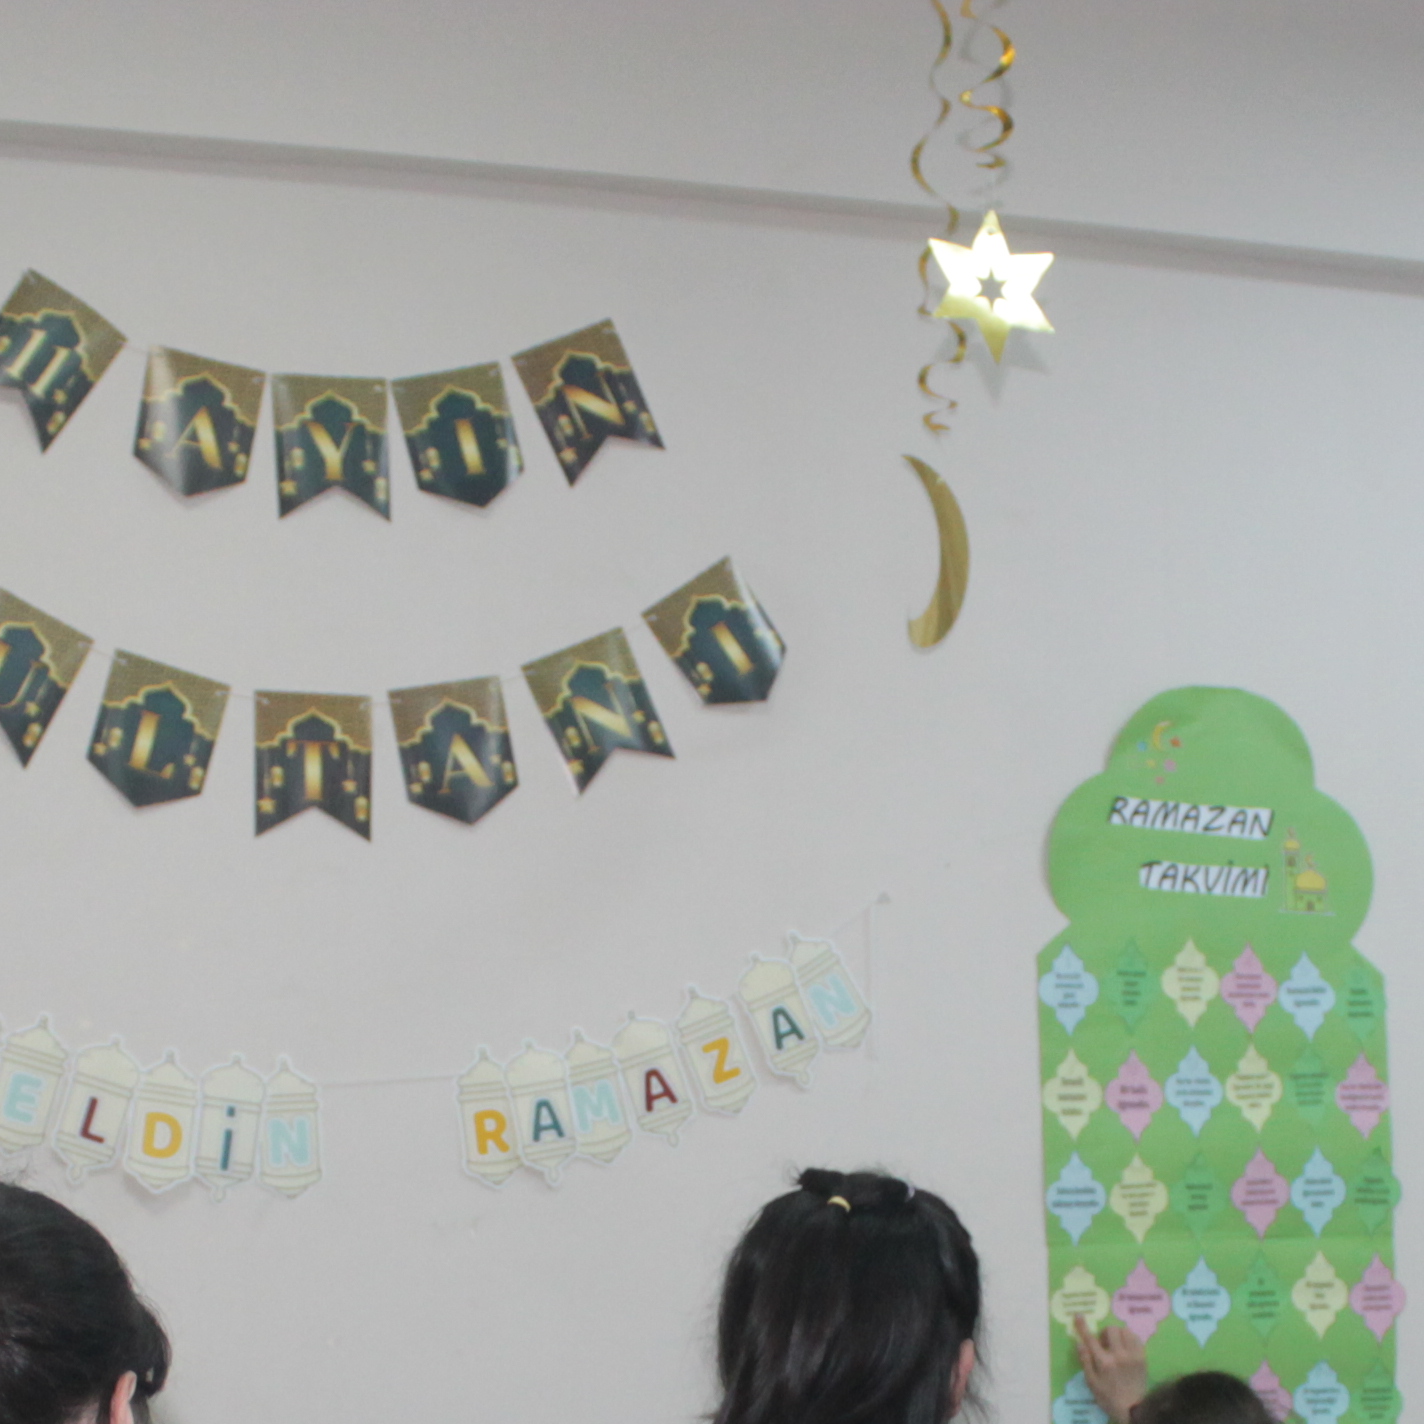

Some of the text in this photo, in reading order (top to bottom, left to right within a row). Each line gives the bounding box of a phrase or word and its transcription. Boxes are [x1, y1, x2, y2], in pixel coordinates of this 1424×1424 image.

[4, 328, 625, 480] 11 AYIN
[1109, 796, 1275, 838] RAMAZAN
[474, 974, 857, 1154] RAMAZAN
